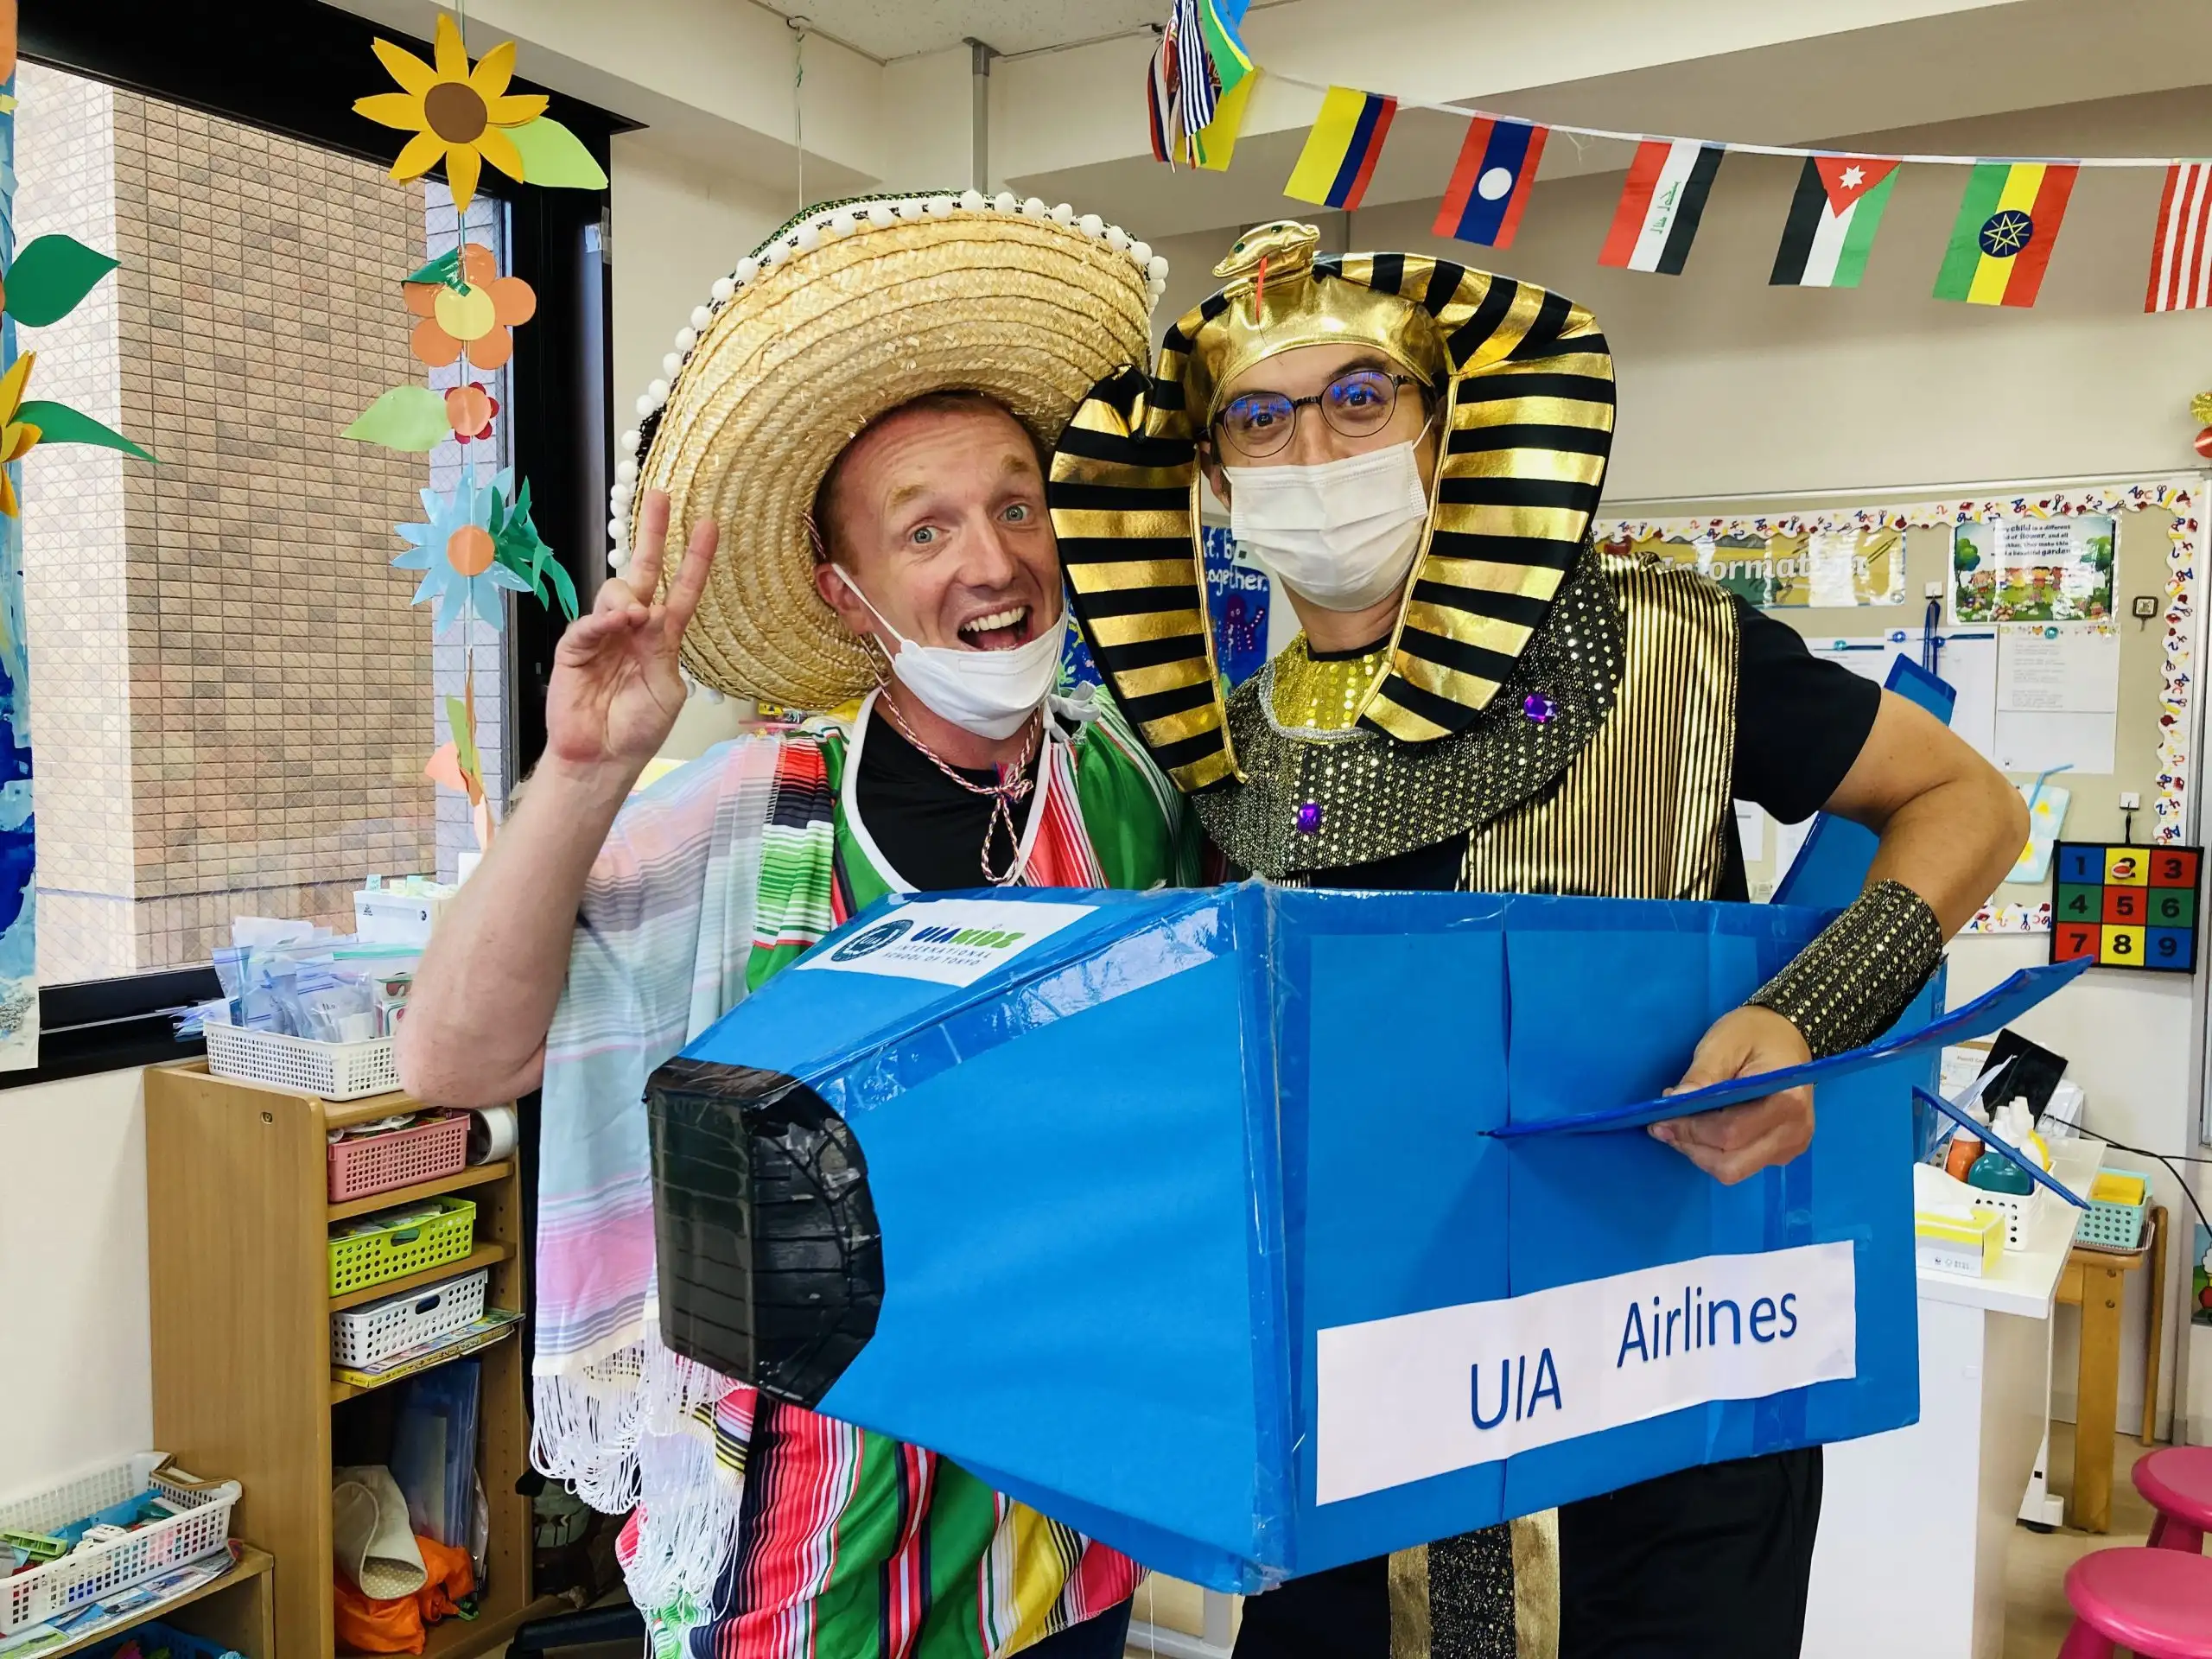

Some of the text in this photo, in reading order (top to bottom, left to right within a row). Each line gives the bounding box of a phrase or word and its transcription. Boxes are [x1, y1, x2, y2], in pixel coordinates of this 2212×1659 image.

[1206, 564, 1268, 597] ogether.
[2075, 856, 2086, 875] 1
[2164, 859, 2183, 879] 3
[2069, 894, 2180, 918] 4 5 6
[895, 944, 992, 958] INTERNATIONAL
[2069, 933, 2177, 957] 7 8 9
[882, 952, 922, 961] SCHOOL
[941, 957, 982, 966] TOKYO
[1471, 1286, 1798, 1431] UIA Airlines
